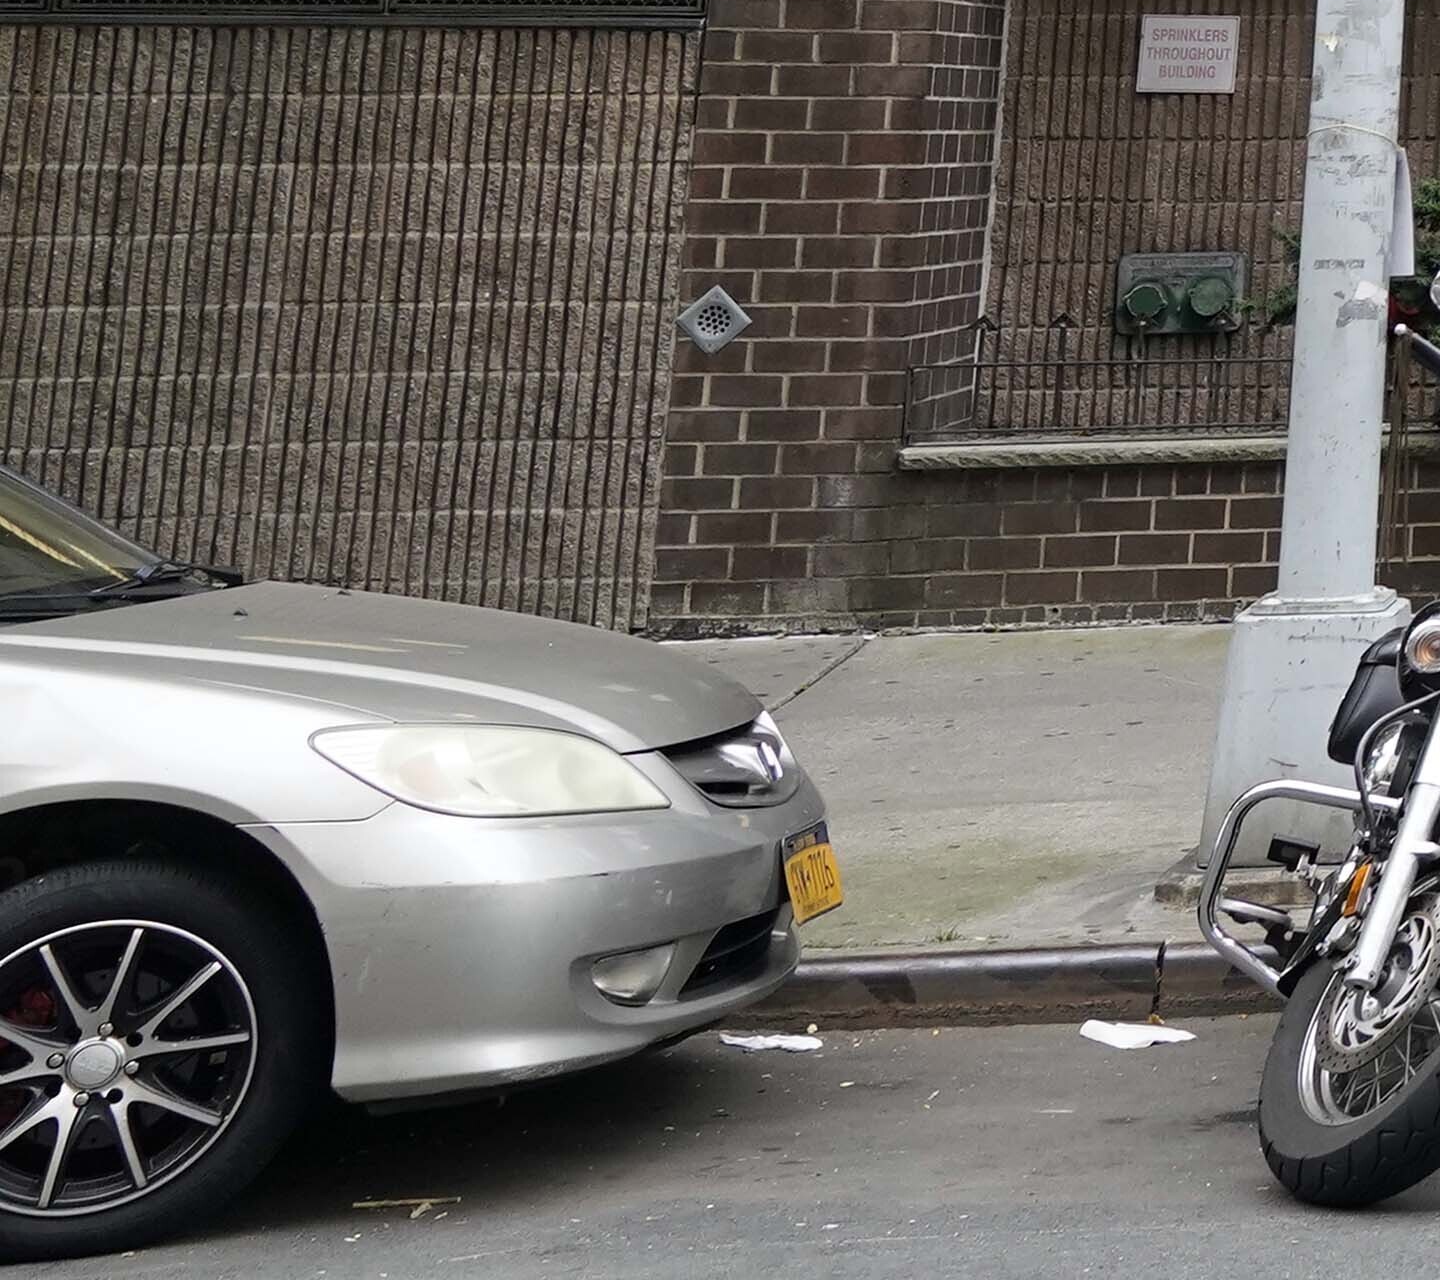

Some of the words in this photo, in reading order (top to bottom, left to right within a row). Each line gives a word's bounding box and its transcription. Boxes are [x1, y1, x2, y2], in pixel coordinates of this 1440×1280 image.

[1152, 28, 1229, 42] SPRINKLERS
[1146, 47, 1232, 61] THROUGHOUT
[1159, 64, 1217, 79] BUILDING
